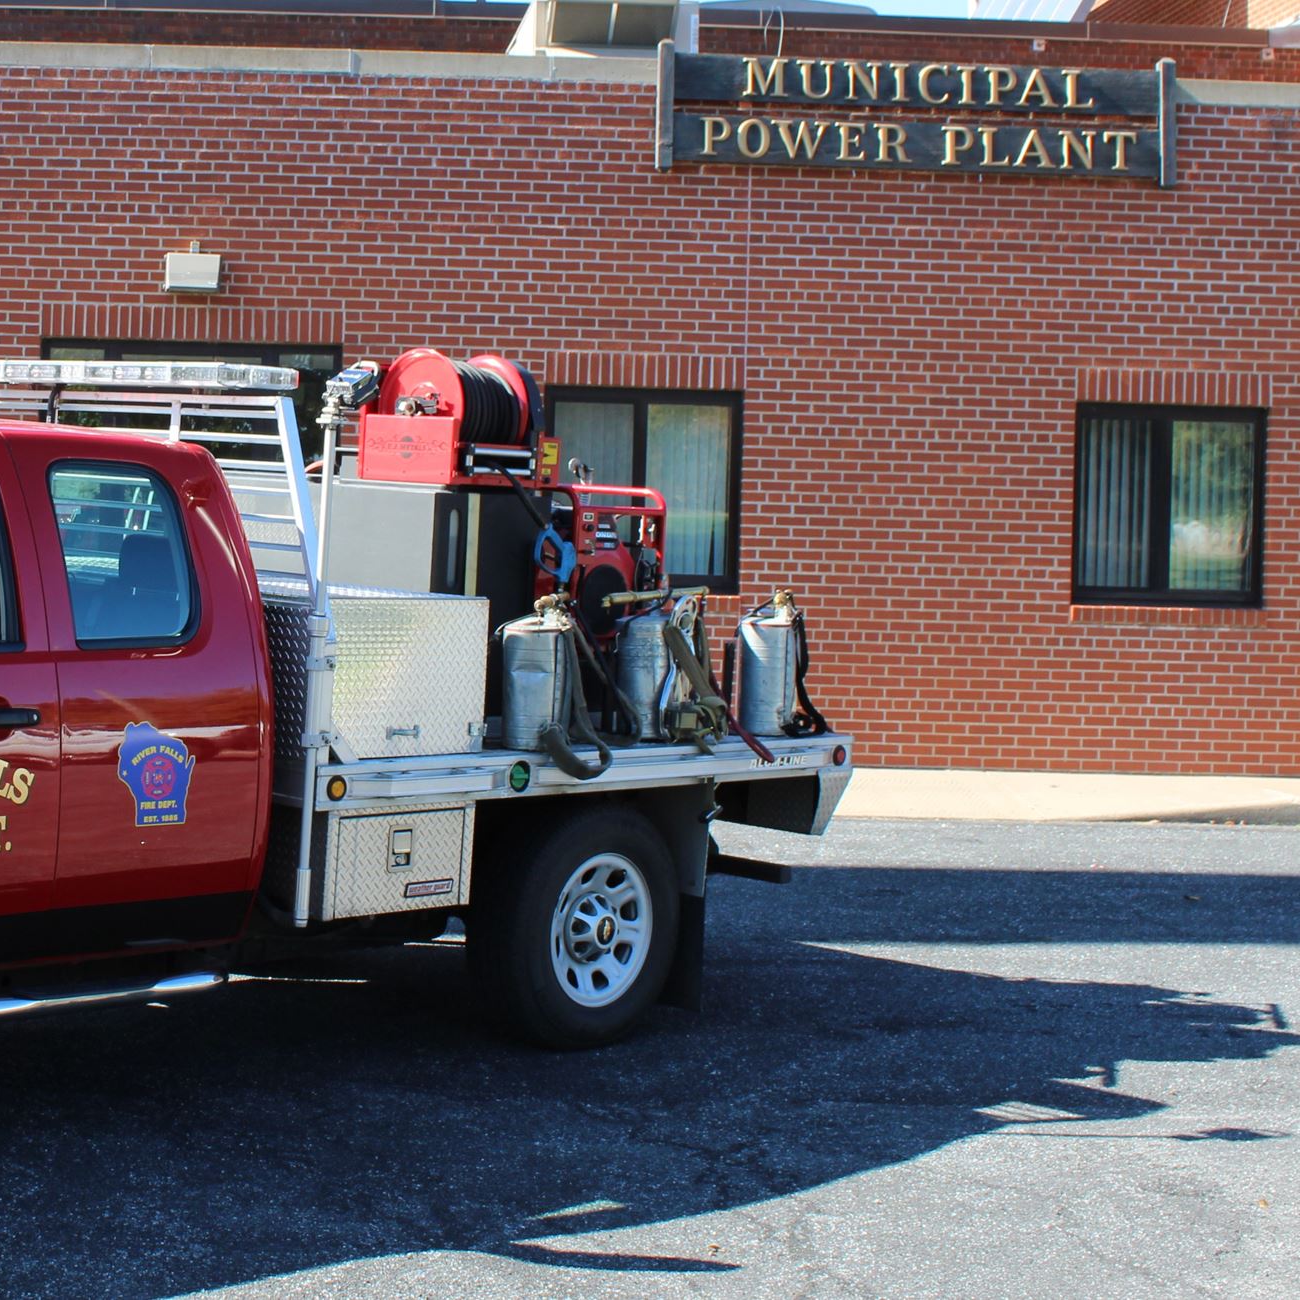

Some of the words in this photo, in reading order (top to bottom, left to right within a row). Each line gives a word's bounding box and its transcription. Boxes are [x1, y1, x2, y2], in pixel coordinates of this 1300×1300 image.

[742, 56, 1094, 109] MUNICIPAL
[701, 116, 912, 163] POWER
[941, 125, 1138, 171] PLANT
[131, 746, 157, 766] RIVER
[159, 745, 184, 764] FALLS
[140, 801, 156, 810] FIRE
[157, 800, 178, 809] DEPT.
[143, 815, 159, 823] EST.
